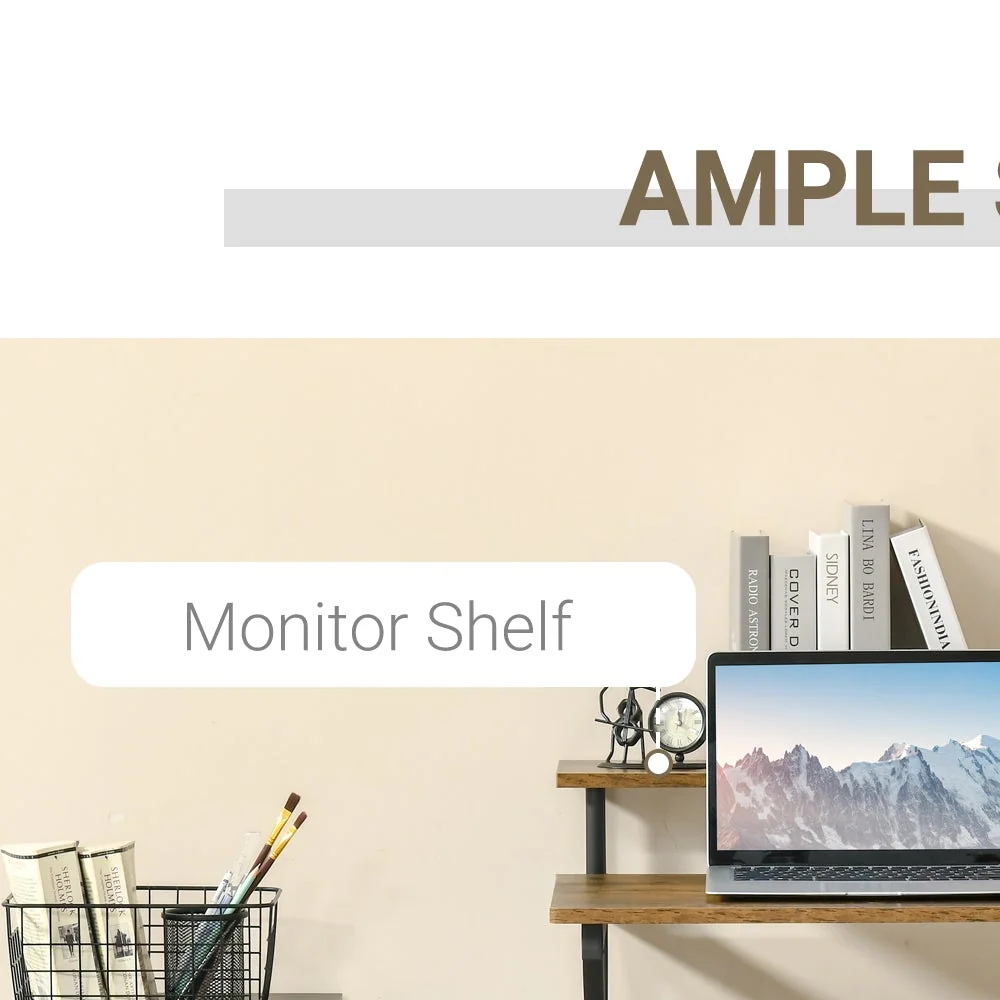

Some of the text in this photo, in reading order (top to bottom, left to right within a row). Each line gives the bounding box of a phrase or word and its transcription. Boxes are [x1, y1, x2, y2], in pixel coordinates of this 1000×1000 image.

[748, 569, 758, 605] RADIO
[825, 553, 839, 604] SIDNEY
[862, 519, 875, 621] LINA BO BARDI
[789, 569, 799, 647] COVER D
[62, 866, 76, 917] SHERLOK
[111, 866, 126, 917] SHERLOK
